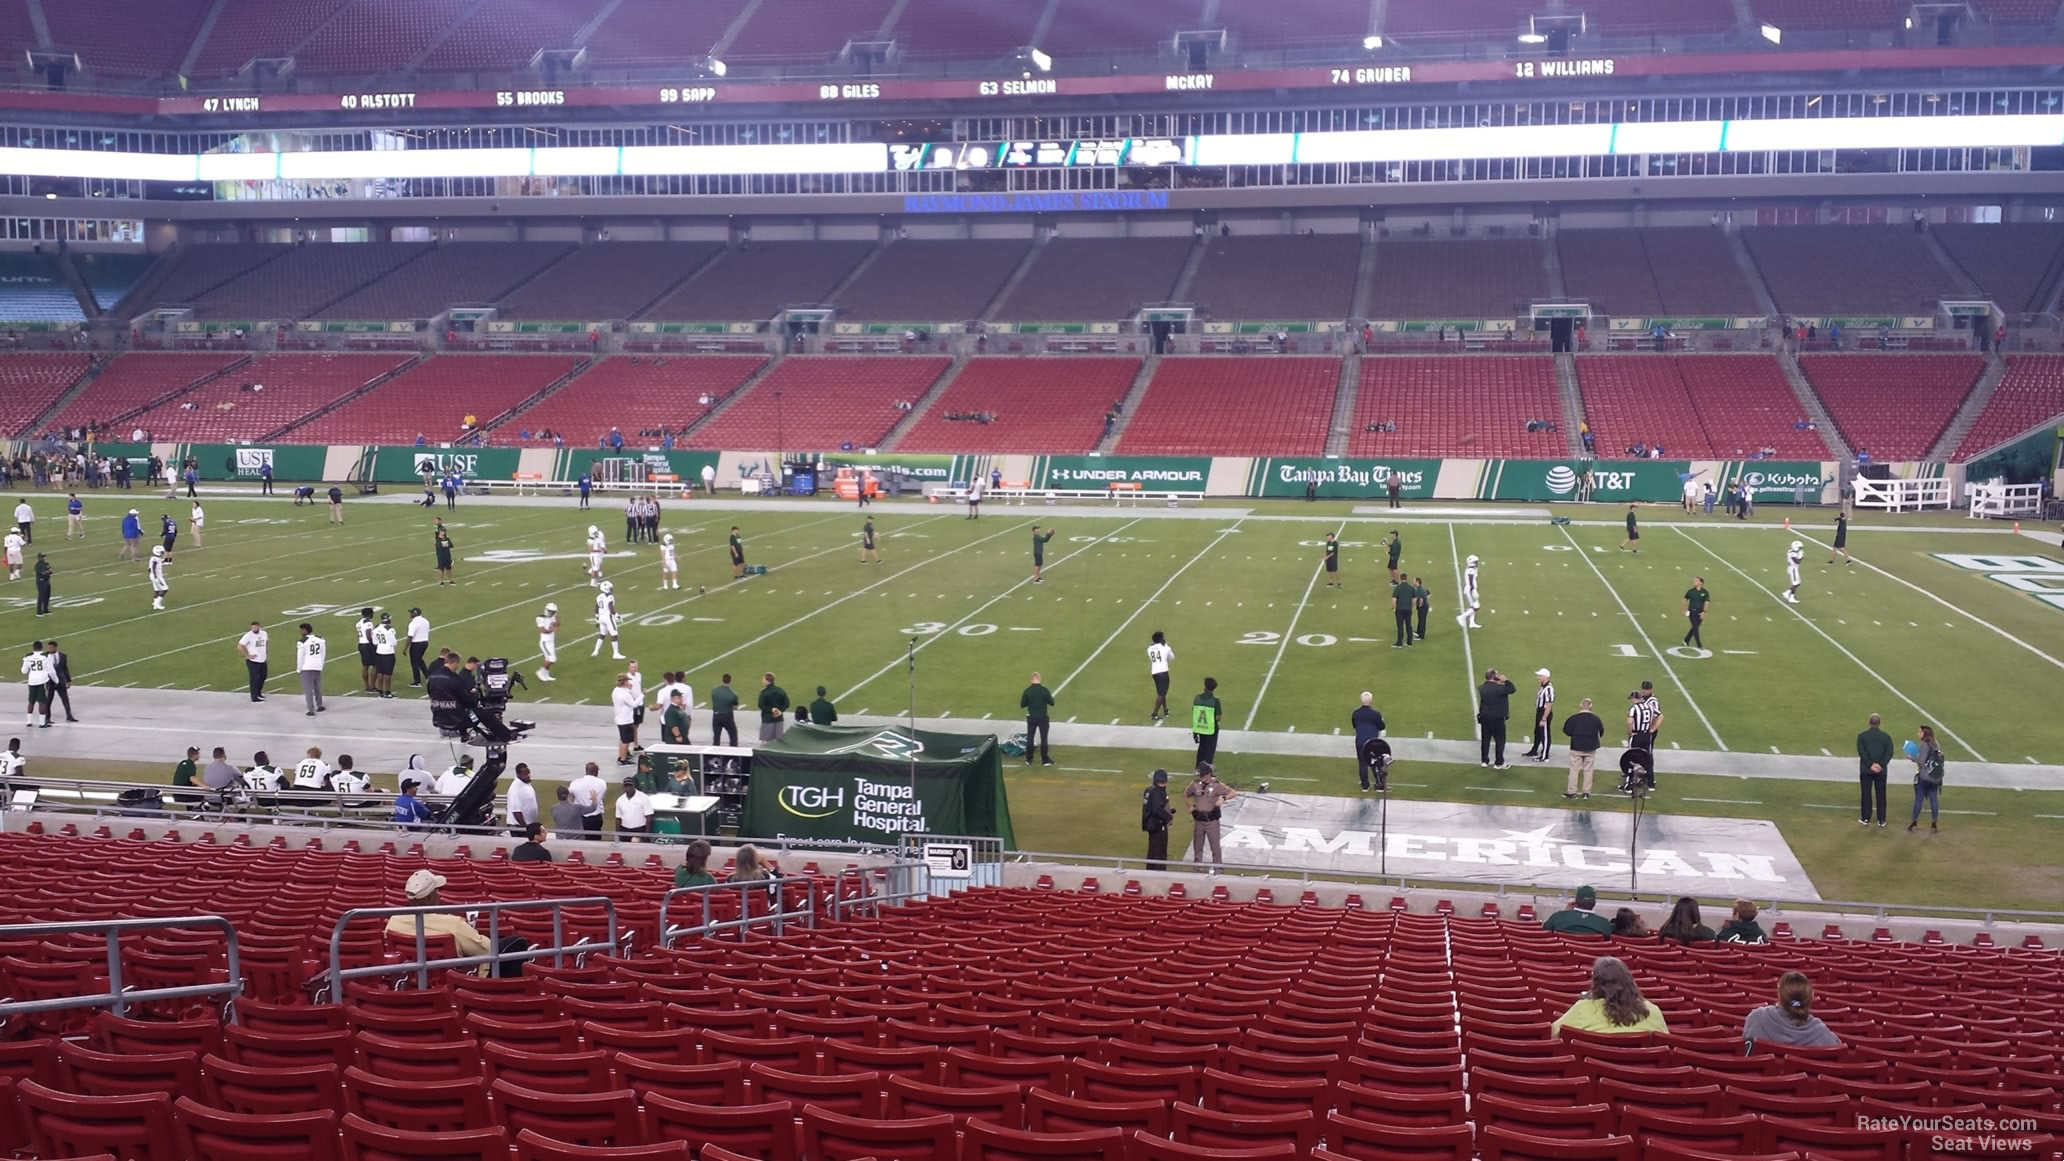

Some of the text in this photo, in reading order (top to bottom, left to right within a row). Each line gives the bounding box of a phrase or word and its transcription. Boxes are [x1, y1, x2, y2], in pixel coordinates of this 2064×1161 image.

[1516, 59, 1614, 77] 12 WILLIAMS
[1331, 67, 1411, 84] 74 GRUBER
[843, 84, 880, 98] GILES
[980, 80, 1056, 95] 63 SELMON
[341, 93, 416, 108] 40 ALSTOTT
[496, 91, 565, 106] 55 BROOKS
[660, 88, 716, 102] 99 SAPP
[203, 97, 259, 111] 47 LYNCH
[905, 191, 1169, 212] RAYMOND JAMES STADIUM
[239, 451, 271, 466] USF
[436, 454, 479, 471] USF
[237, 468, 262, 476] HEAL
[1072, 470, 1127, 480] UNDER
[1338, 465, 1370, 487] Bay
[1767, 473, 1819, 485] Kubota
[309, 643, 321, 656] 92
[1150, 650, 1162, 663] 84
[30, 660, 44, 672] 28
[1642, 709, 1651, 723] B
[300, 764, 317, 778] 69
[251, 777, 267, 790] 75
[338, 782, 351, 793] 61
[854, 777, 913, 800] Tampa
[787, 785, 844, 808] TGH
[854, 794, 922, 816] General
[1219, 824, 1787, 883] AMERICAN
